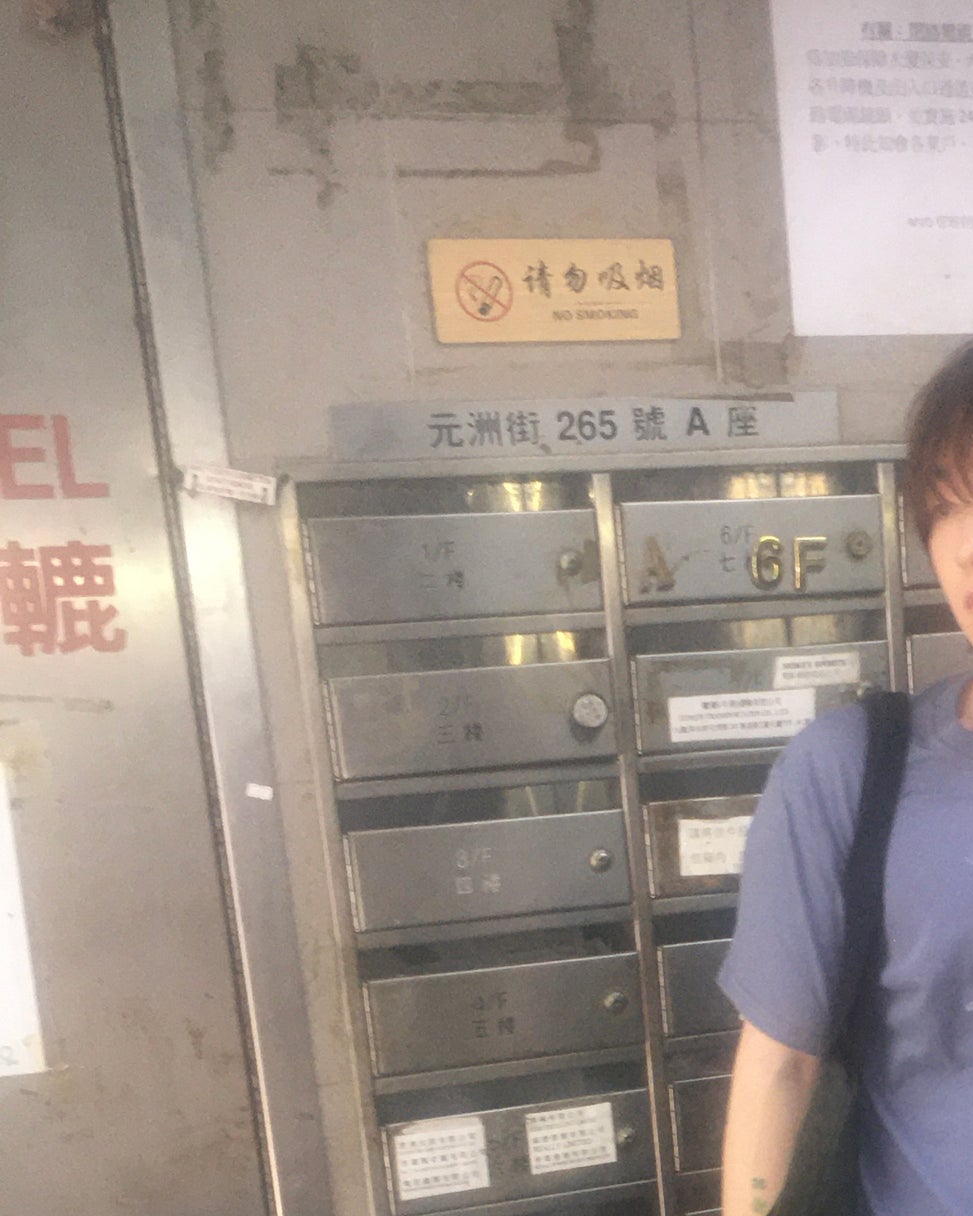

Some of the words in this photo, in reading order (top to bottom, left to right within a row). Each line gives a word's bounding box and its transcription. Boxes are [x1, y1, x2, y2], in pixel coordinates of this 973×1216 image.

[522, 257, 665, 298] 请勿吸烟
[552, 310, 573, 322] NO
[576, 308, 639, 322] SMOKING
[428, 411, 540, 448] 元洲街
[556, 409, 618, 442] 265
[632, 406, 668, 442] 號
[686, 406, 711, 438] A
[726, 405, 760, 438] 座
[750, 534, 827, 591] 6F
